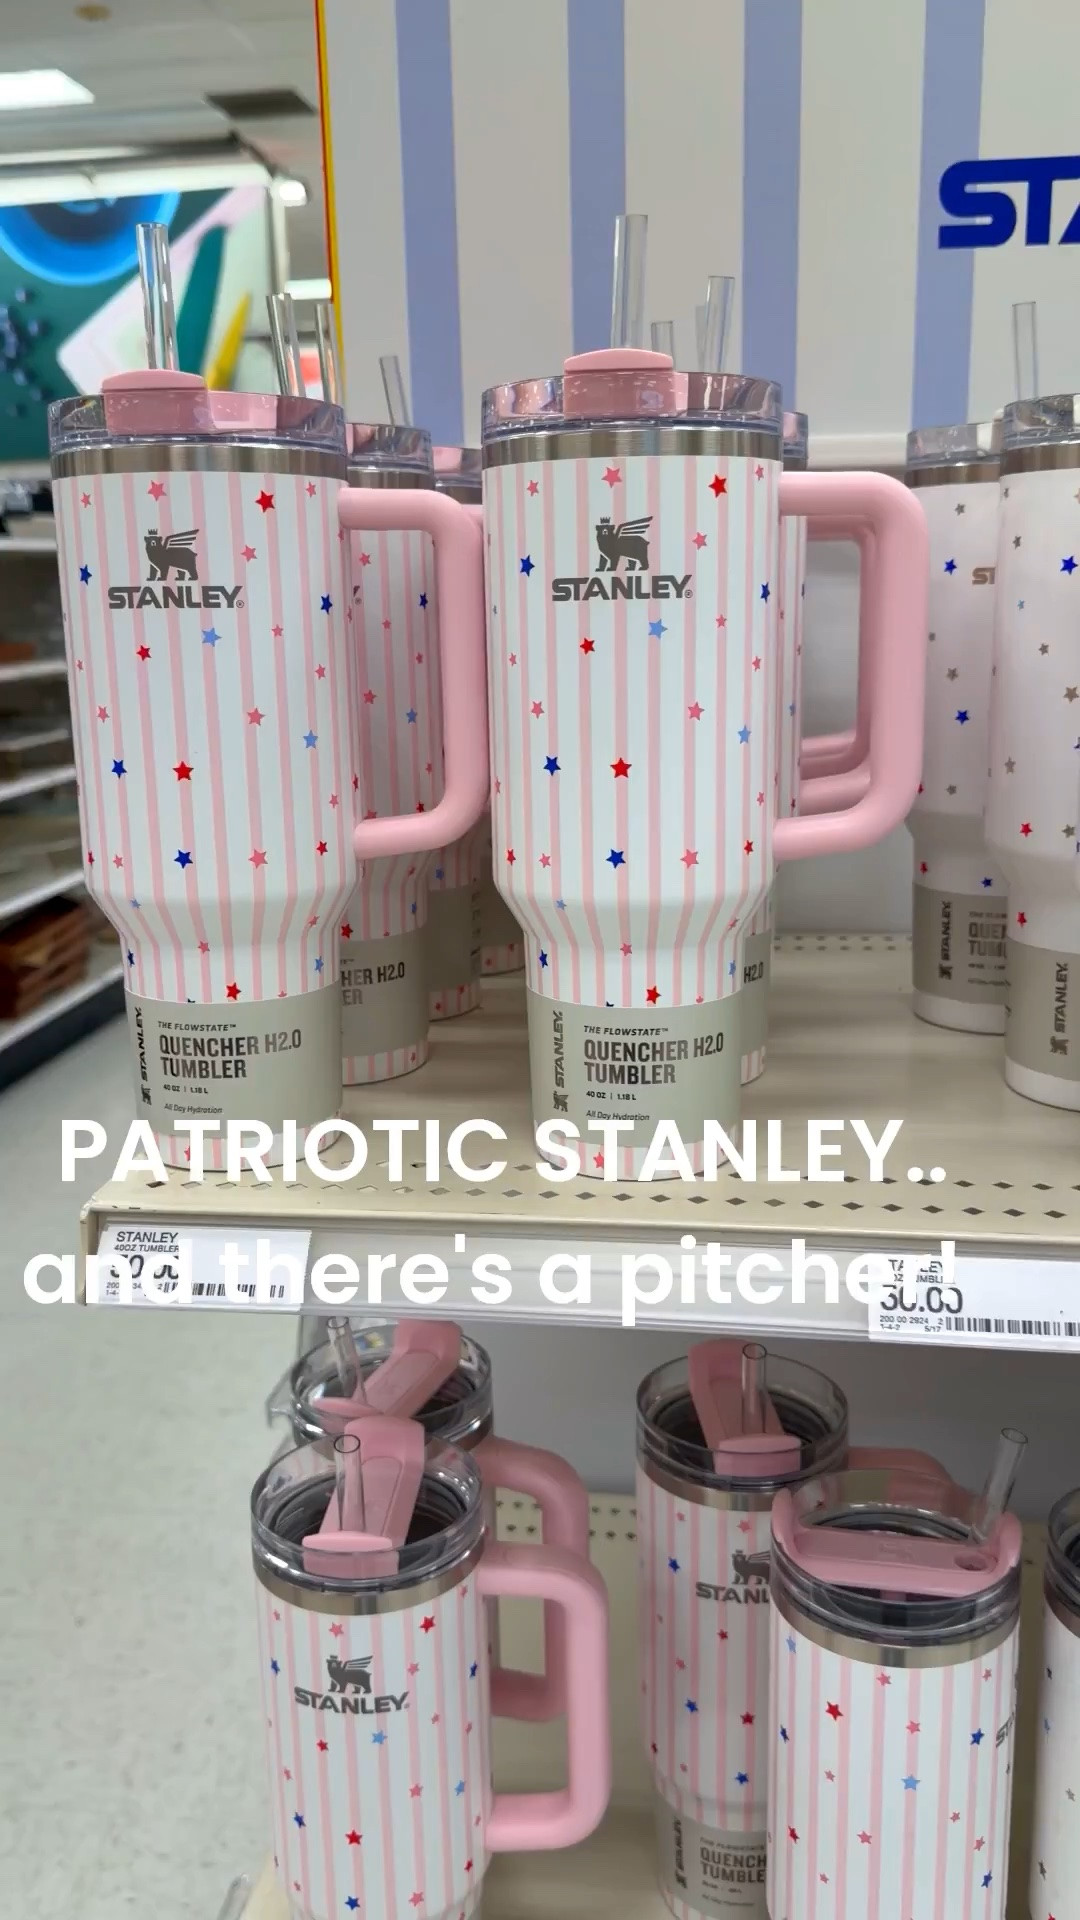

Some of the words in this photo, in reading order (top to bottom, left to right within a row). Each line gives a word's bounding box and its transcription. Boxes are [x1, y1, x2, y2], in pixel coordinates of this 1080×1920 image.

[972, 567, 996, 585] ST
[968, 922, 1007, 939] QUE
[341, 968, 373, 987] HER
[377, 961, 405, 983] H2.0
[342, 989, 363, 1005] ER
[157, 1021, 172, 1029] THE
[584, 1025, 600, 1034] THE
[159, 1034, 259, 1058] QUENCHER
[265, 1029, 302, 1053] H2.0
[584, 1039, 689, 1062] QUENCHER
[693, 1032, 724, 1058] H2.0
[160, 1057, 247, 1079] TUMBLER
[584, 1062, 676, 1085] TUMBLER
[586, 1090, 595, 1098] 40
[596, 1091, 606, 1099] OZ
[632, 1093, 637, 1101] L
[586, 1110, 596, 1118] All
[597, 1111, 611, 1120] Day
[116, 1231, 179, 1243] STANLEY
[696, 1581, 770, 1604] STANL
[700, 1847, 767, 1869] QUENCH
[700, 1861, 766, 1884] TUMBLE
